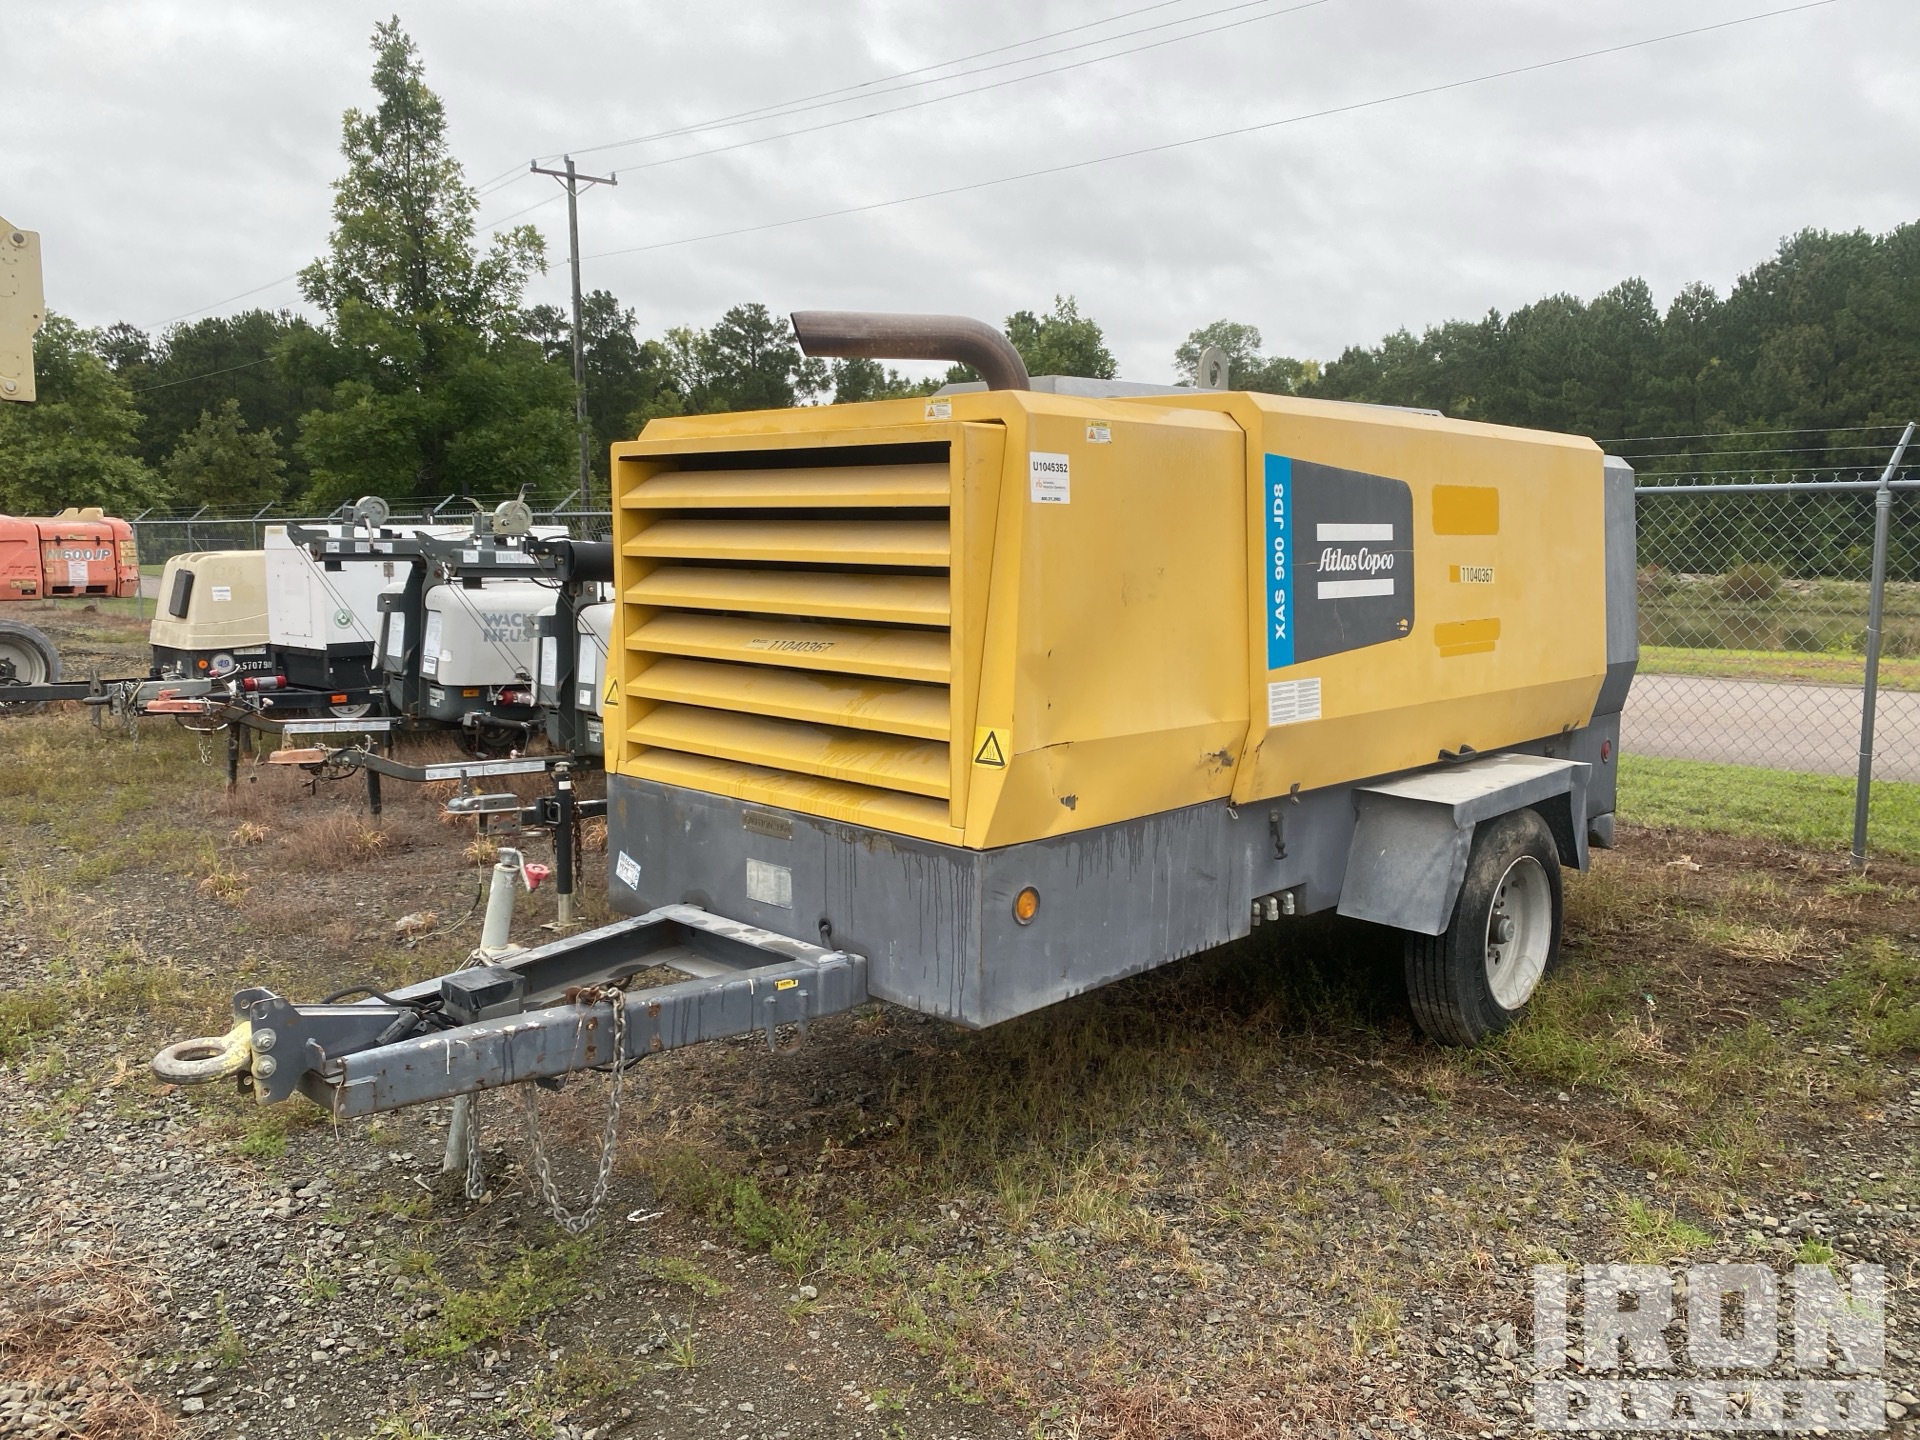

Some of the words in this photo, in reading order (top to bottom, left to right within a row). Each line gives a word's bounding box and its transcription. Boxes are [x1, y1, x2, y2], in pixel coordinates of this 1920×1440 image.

[1033, 461, 1068, 473] U1045352
[1273, 483, 1285, 531] JD8
[46, 549, 111, 561] M600JP
[1274, 537, 1286, 581] 900
[1317, 547, 1357, 573] Atlas
[1357, 547, 1394, 575] Copco
[1462, 567, 1493, 583] 11040367
[1275, 589, 1286, 640] XAS
[767, 640, 836, 653] 11040367
